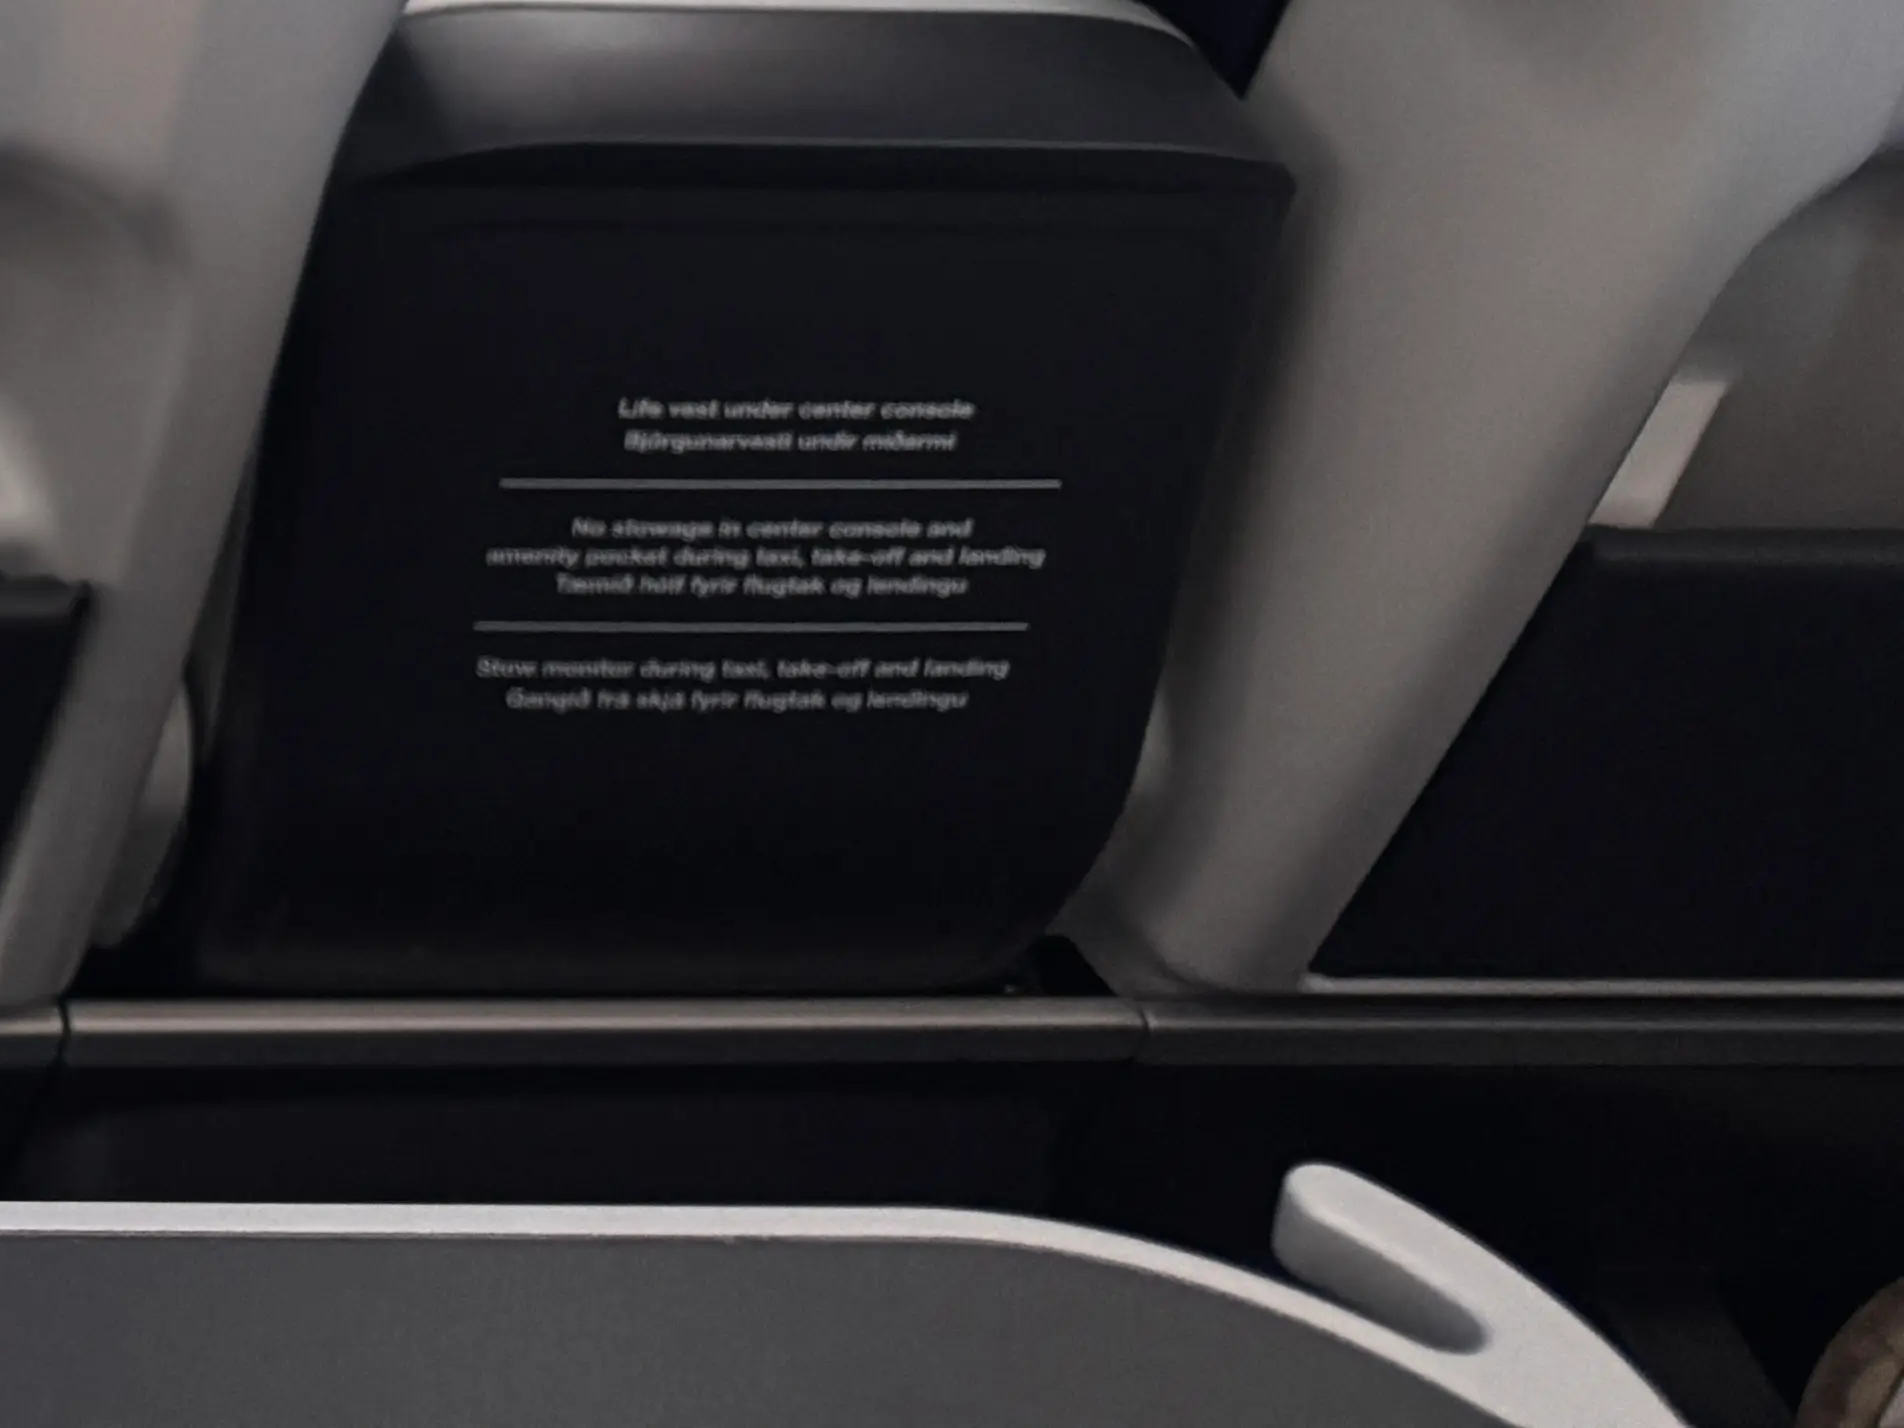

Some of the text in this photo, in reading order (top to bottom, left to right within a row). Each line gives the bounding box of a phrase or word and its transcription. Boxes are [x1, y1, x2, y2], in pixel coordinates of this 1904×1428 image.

[724, 400, 794, 420] under
[925, 518, 974, 538] and
[908, 547, 954, 567] and
[875, 659, 918, 678] and
